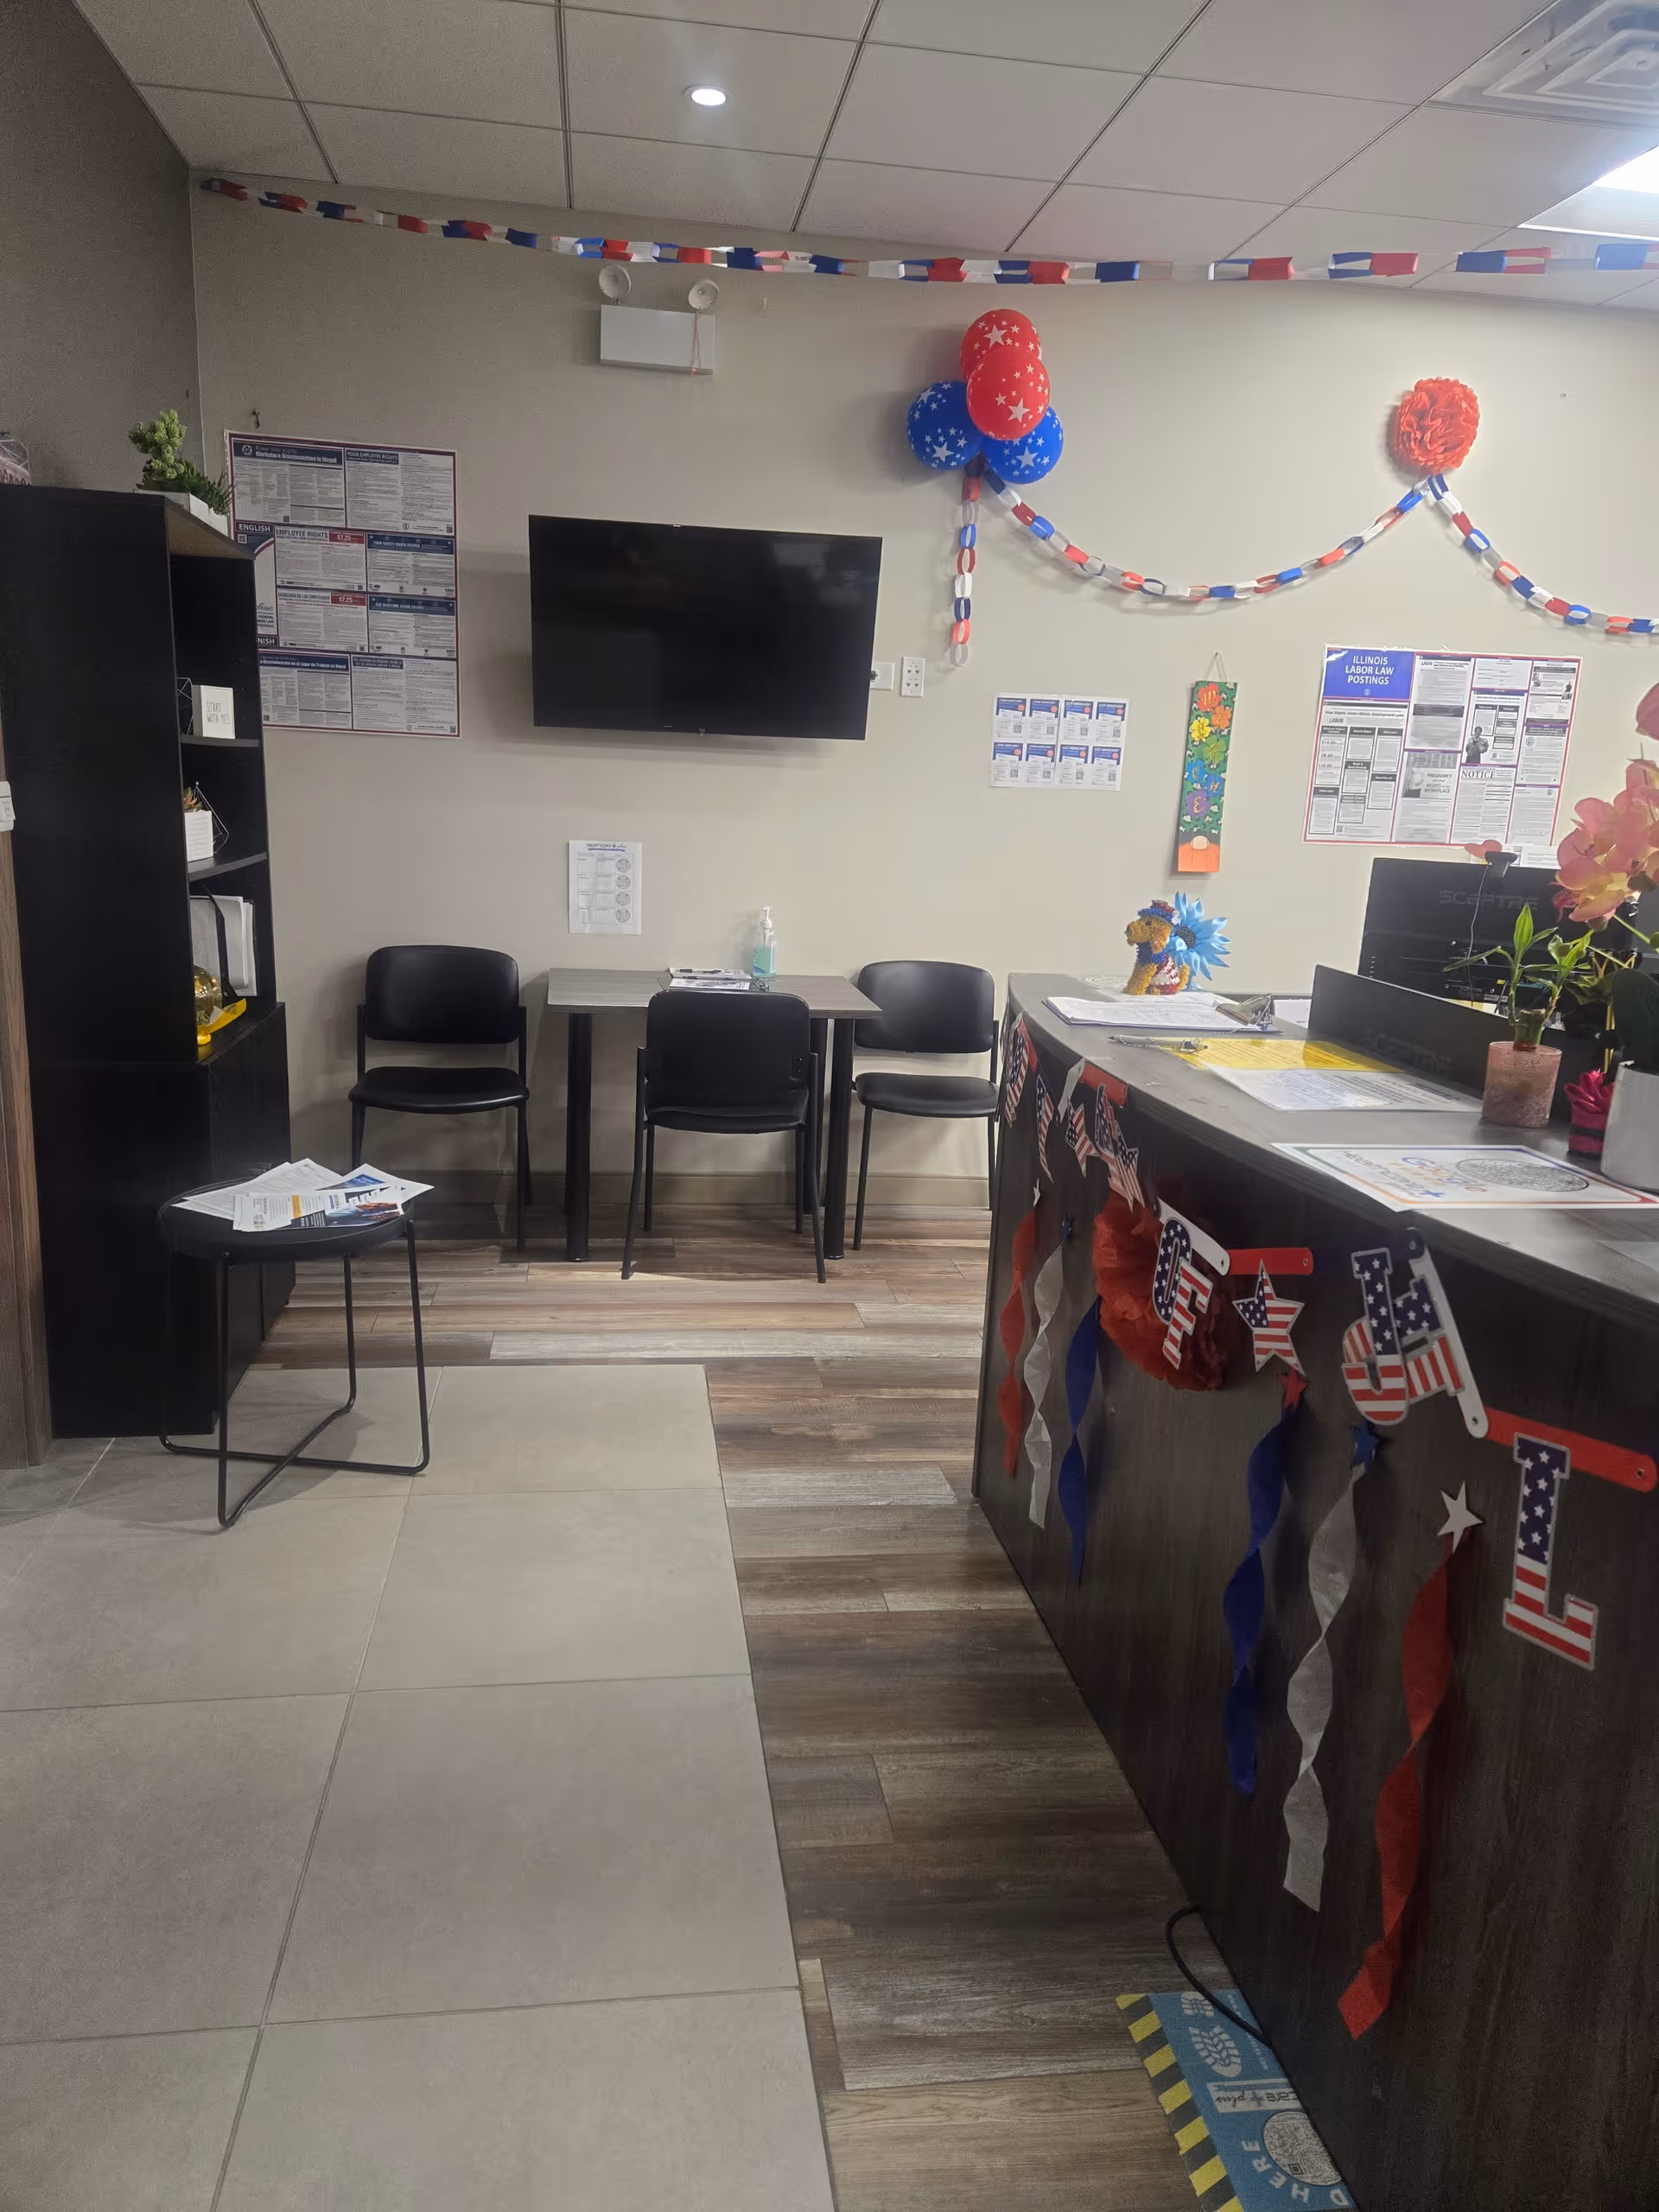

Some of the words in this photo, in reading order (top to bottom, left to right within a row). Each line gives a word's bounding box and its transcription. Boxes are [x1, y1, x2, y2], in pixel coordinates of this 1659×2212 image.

[239, 524, 270, 532] ENGLISH
[1353, 656, 1389, 664] ILLINOIS
[1344, 665, 1374, 674] LABOR
[1347, 675, 1389, 684] POSTINGS
[207, 702, 222, 712] START
[207, 713, 219, 723] WITH
[220, 714, 230, 725] YES
[1461, 770, 1496, 779] NOTICE
[1401, 1157, 1488, 1192] Google
[1215, 2089, 1246, 2108] plus
[1241, 2139, 1310, 2203] HERE
